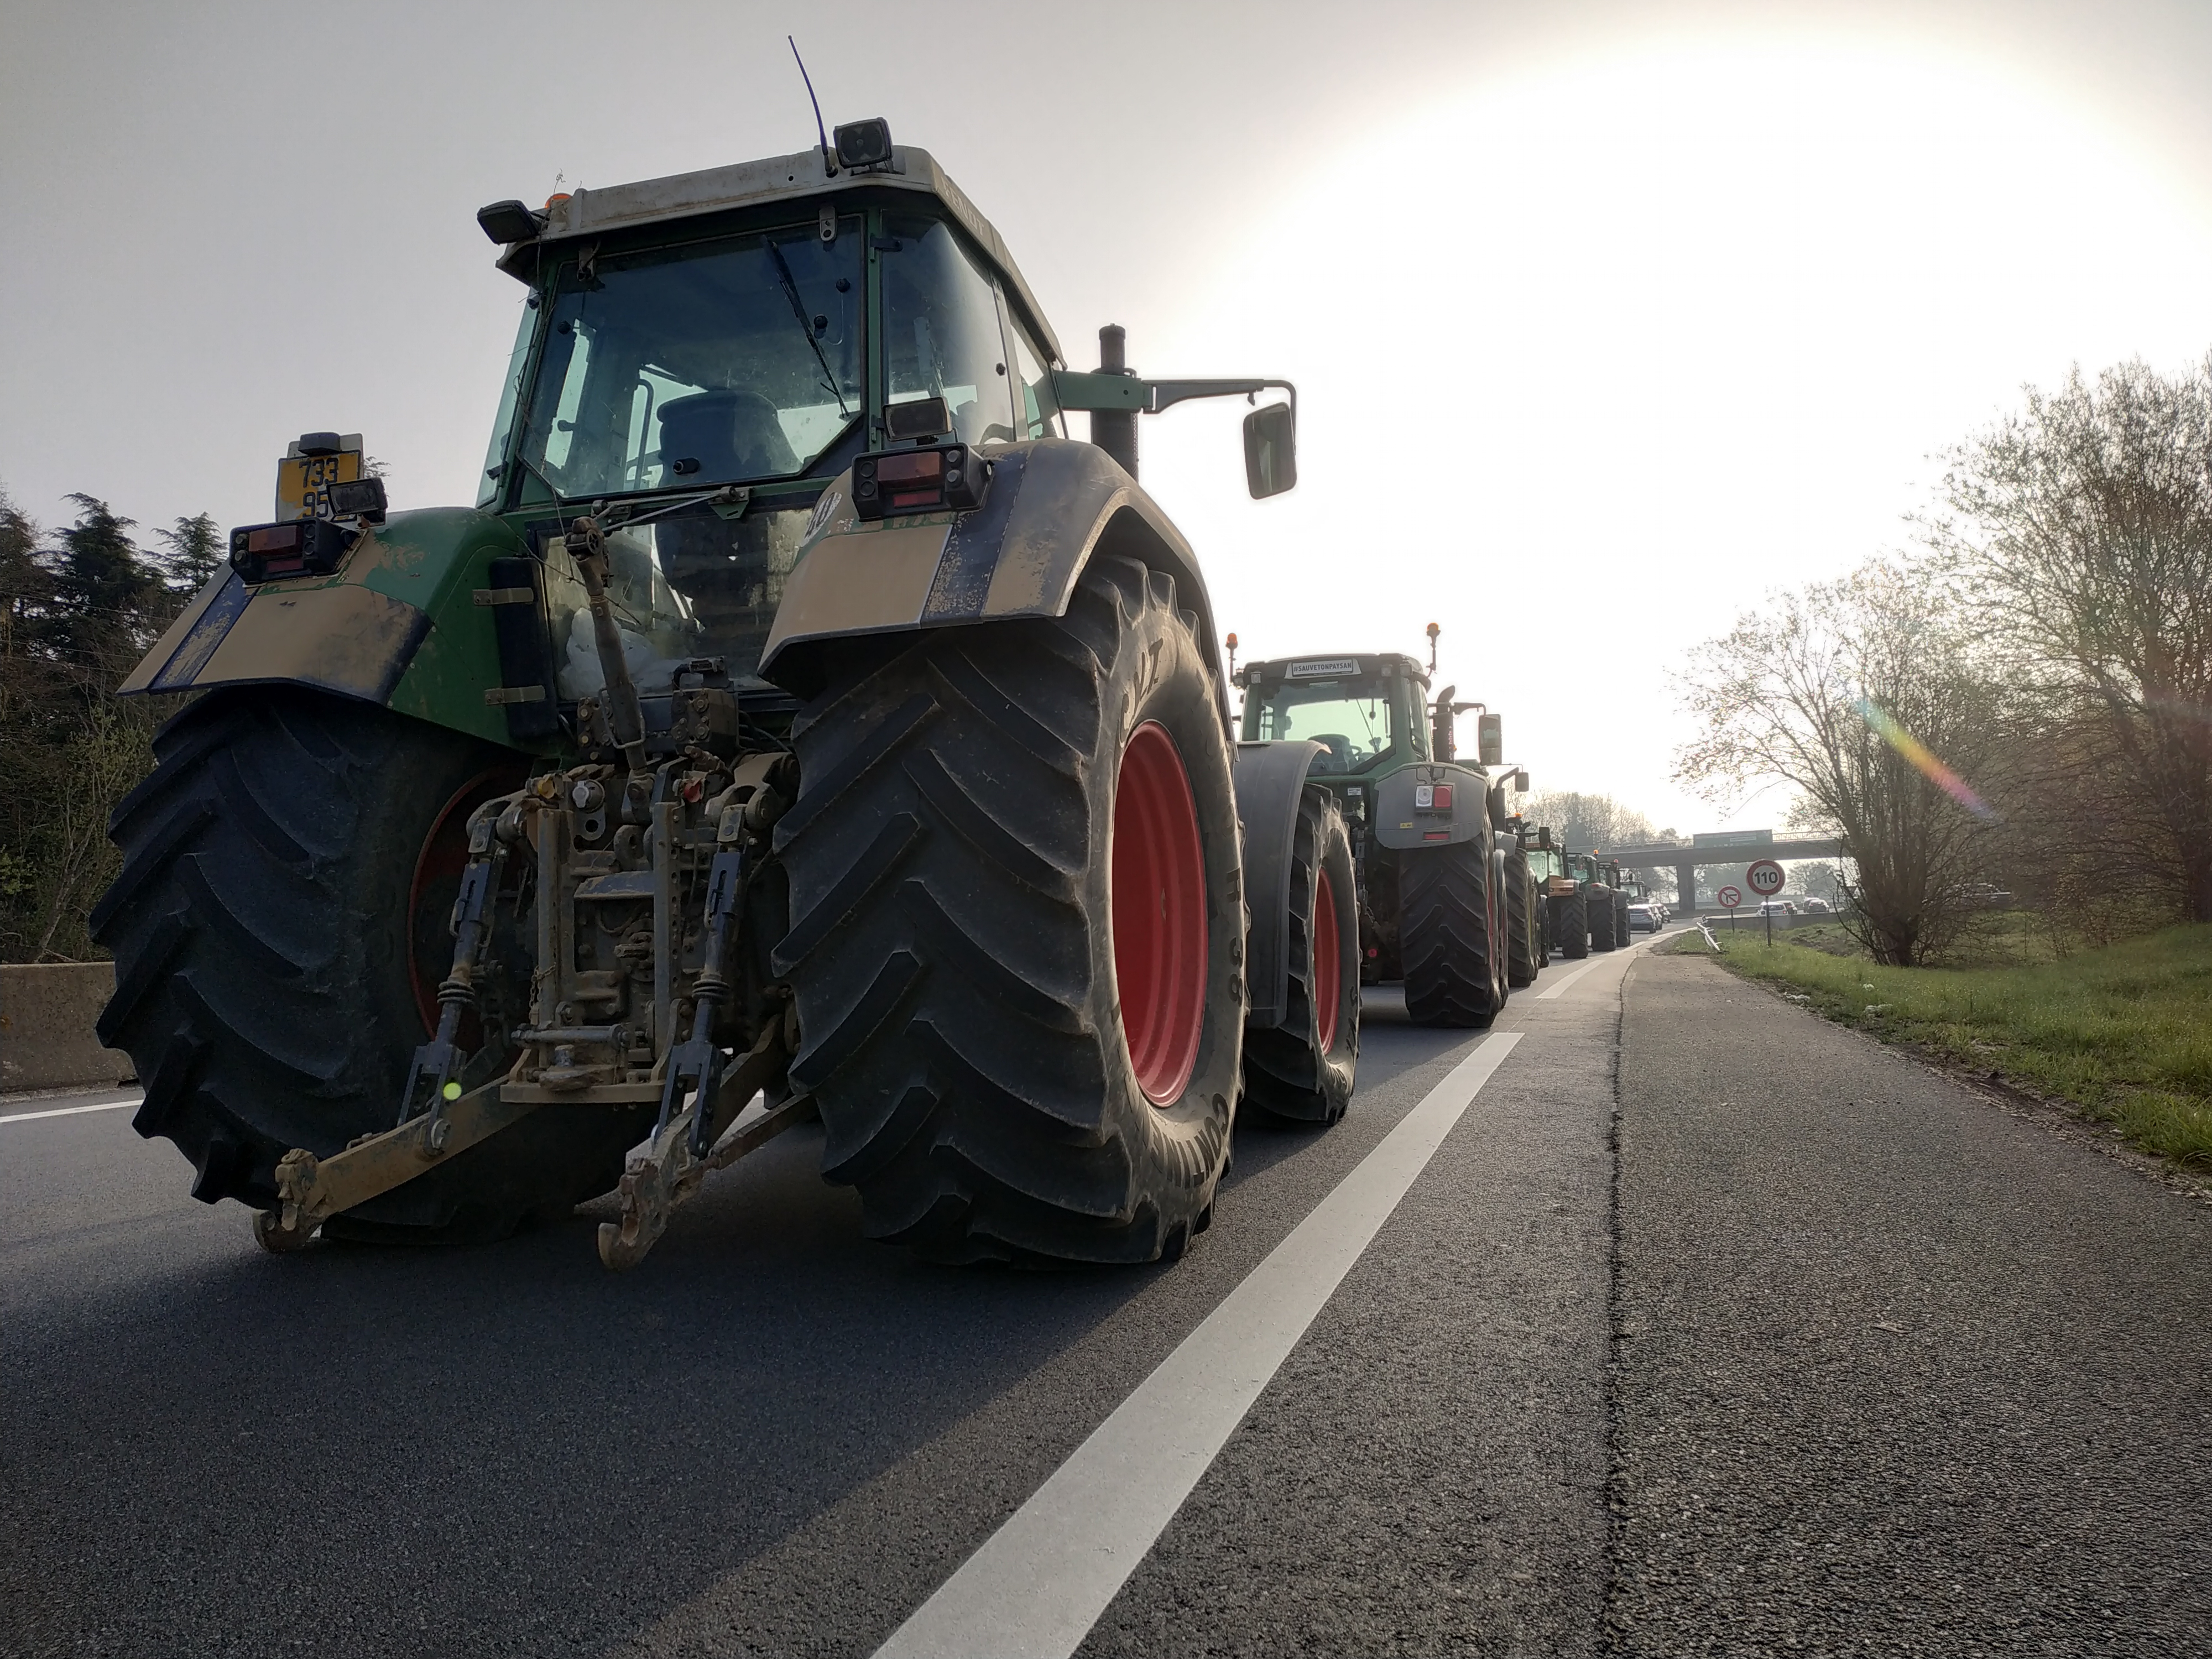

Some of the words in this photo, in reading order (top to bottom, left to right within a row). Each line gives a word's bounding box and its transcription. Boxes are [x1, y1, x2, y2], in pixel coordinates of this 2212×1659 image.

[299, 457, 339, 489] 733
[1293, 662, 1352, 672] #SAUVETONPAYSAN
[1754, 871, 1778, 884] 110
[1228, 936, 1244, 1008] 38
